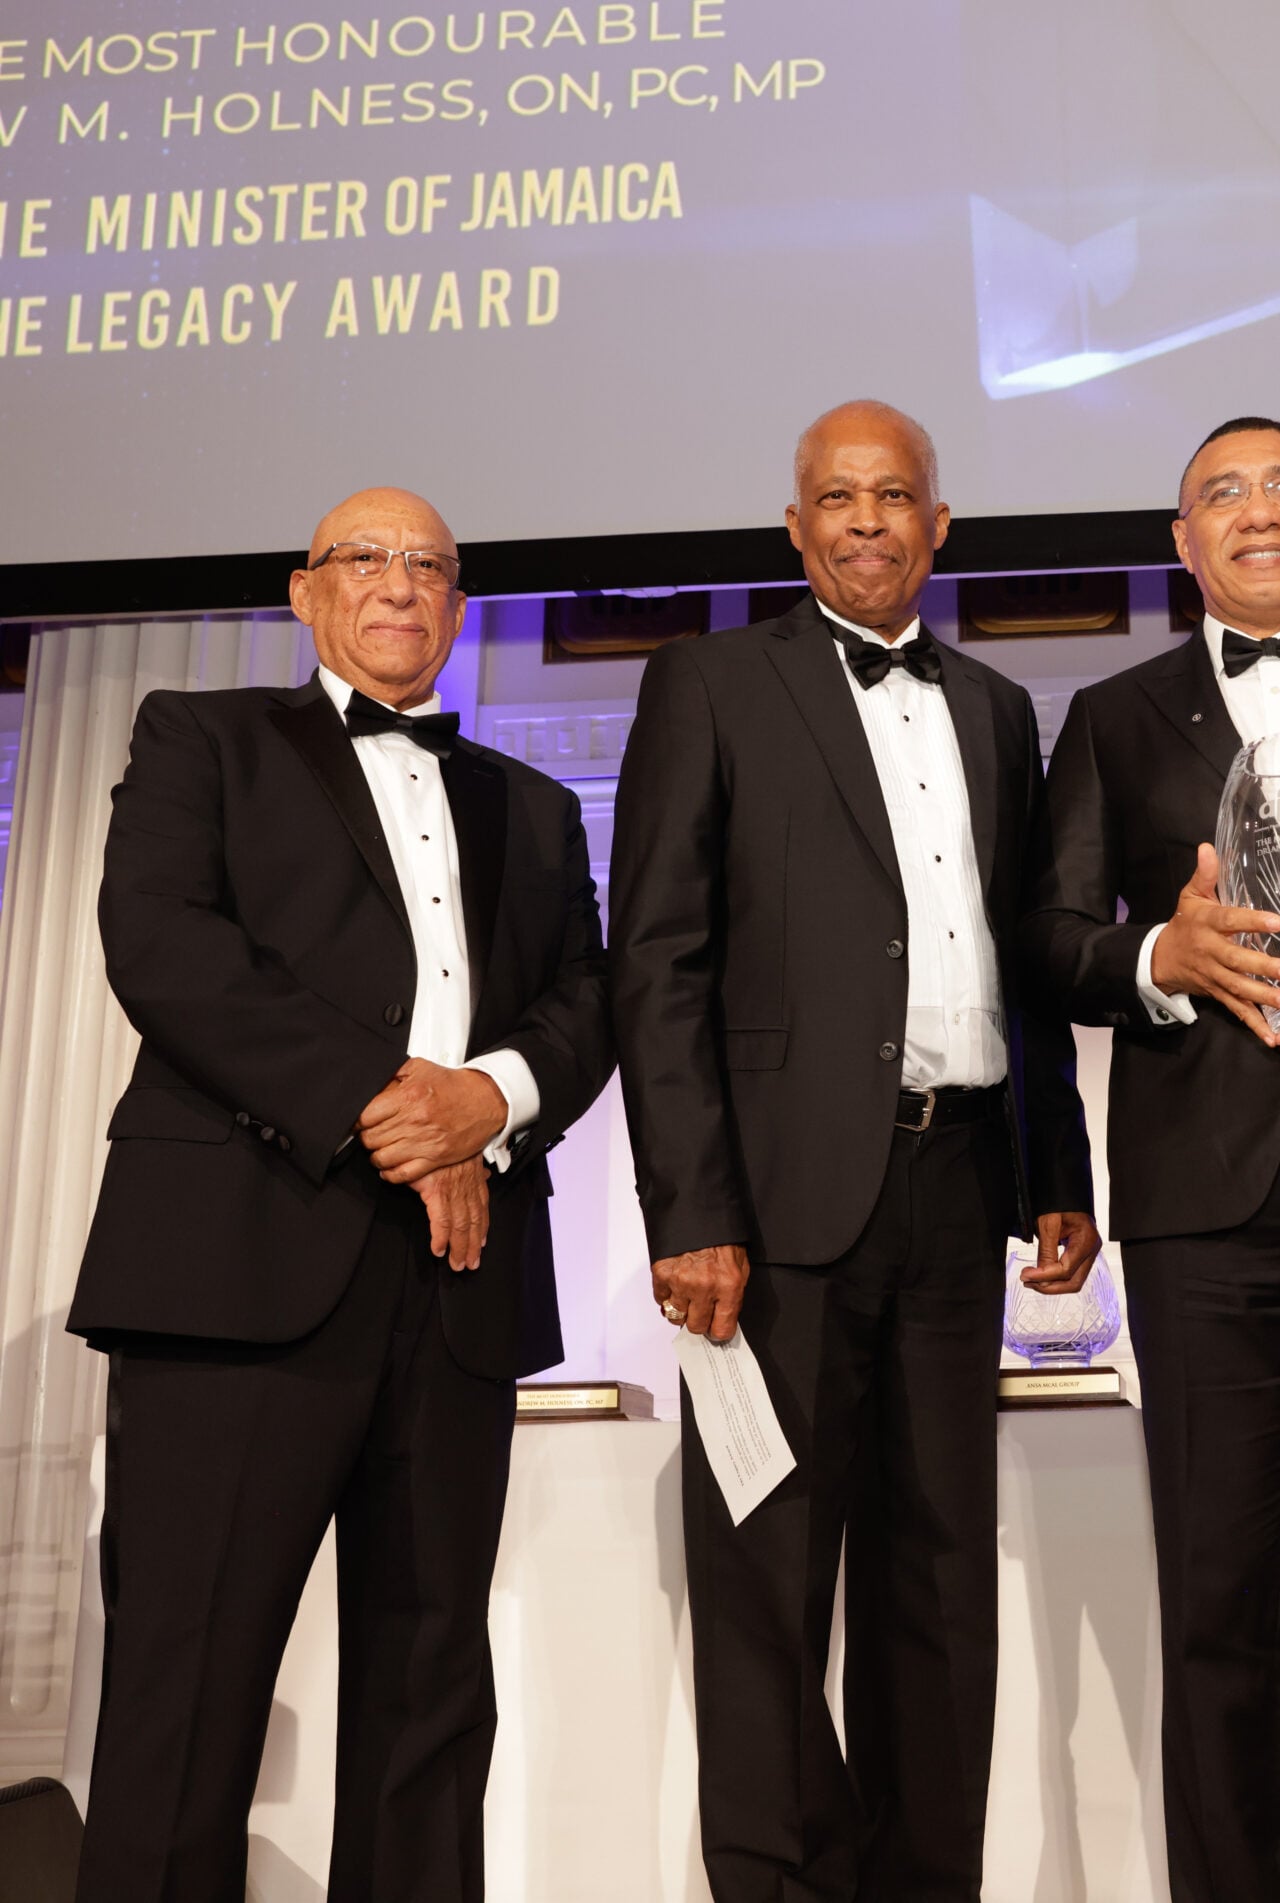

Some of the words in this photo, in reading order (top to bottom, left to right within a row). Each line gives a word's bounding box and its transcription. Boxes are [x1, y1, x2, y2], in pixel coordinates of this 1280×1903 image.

[43, 29, 217, 80] MOST
[234, 0, 728, 68] HONOURABLE
[58, 101, 129, 145] M.
[162, 79, 490, 139] HOLNESS,
[507, 71, 614, 118] ON,
[630, 65, 719, 112] PC,
[734, 59, 827, 103] MP
[86, 180, 369, 255] MINISTER
[384, 175, 452, 238] OF
[460, 161, 684, 232] JAMAICA
[66, 282, 298, 356] LEGACY
[324, 266, 562, 340] AWARD
